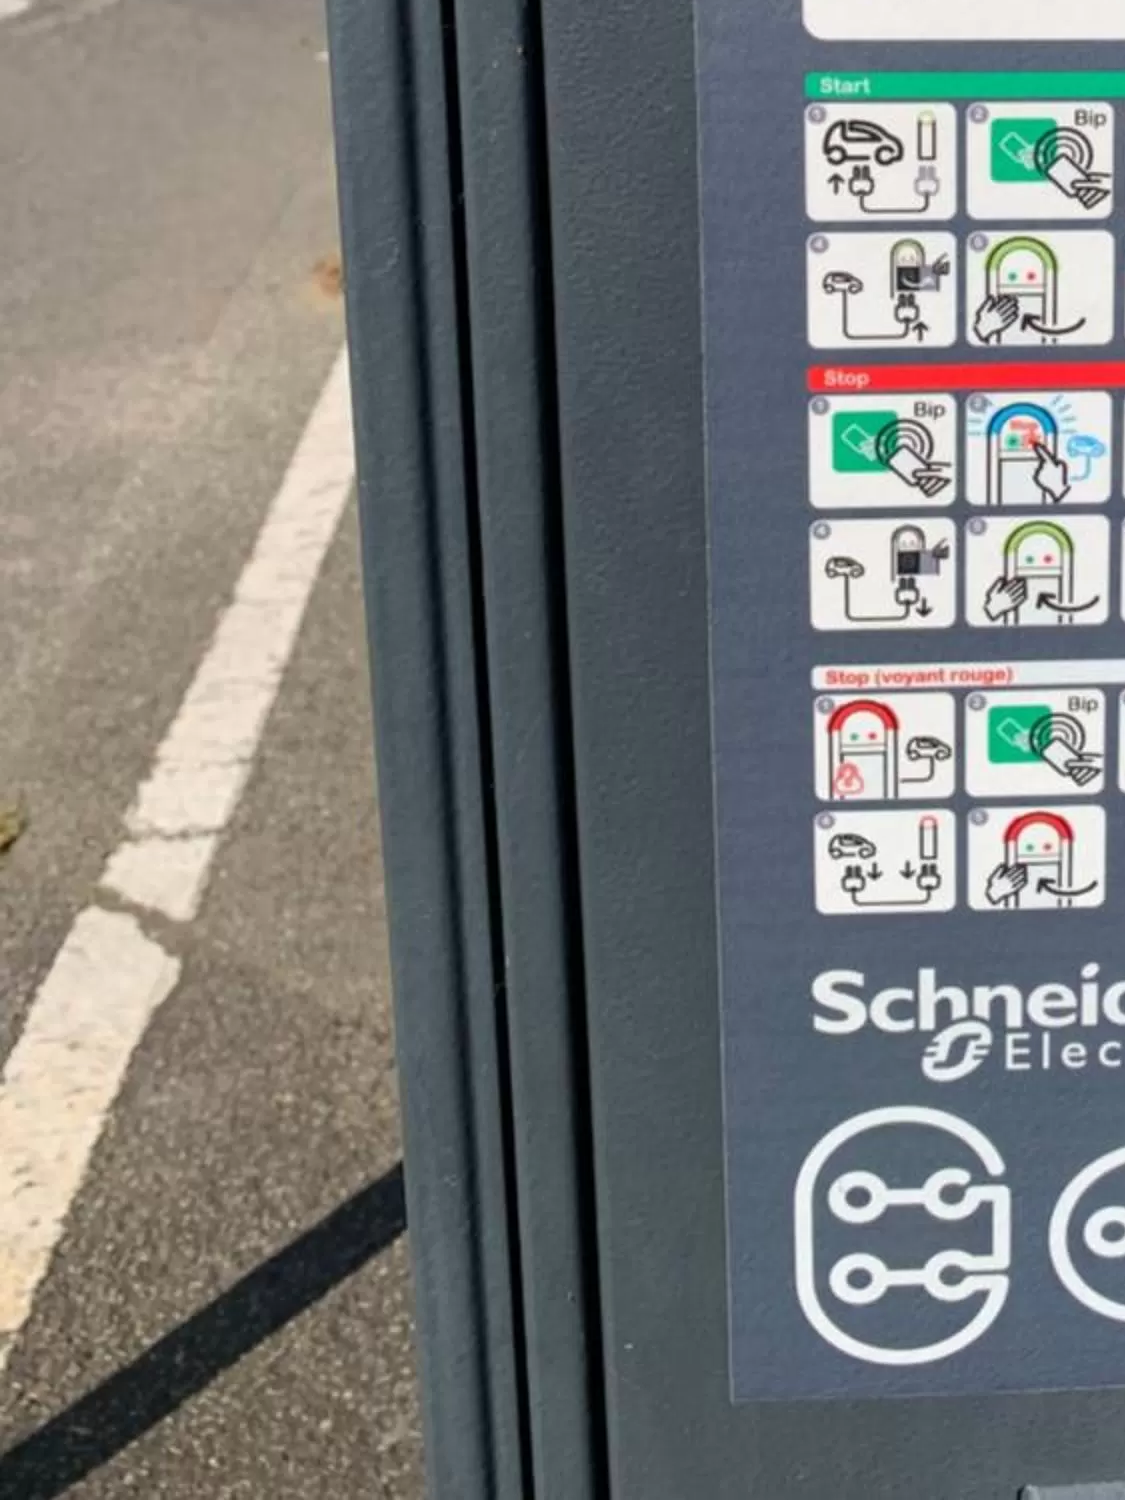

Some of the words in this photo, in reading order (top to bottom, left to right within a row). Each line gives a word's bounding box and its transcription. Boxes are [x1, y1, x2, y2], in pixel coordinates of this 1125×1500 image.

[820, 77, 870, 95] Start
[1074, 109, 1106, 127] Bip
[824, 371, 869, 388] Stop
[914, 403, 945, 419] Bip
[826, 670, 869, 686] Stop
[875, 668, 944, 686] (voyant
[951, 667, 1013, 685] rouge)
[1068, 696, 1099, 713] Bip
